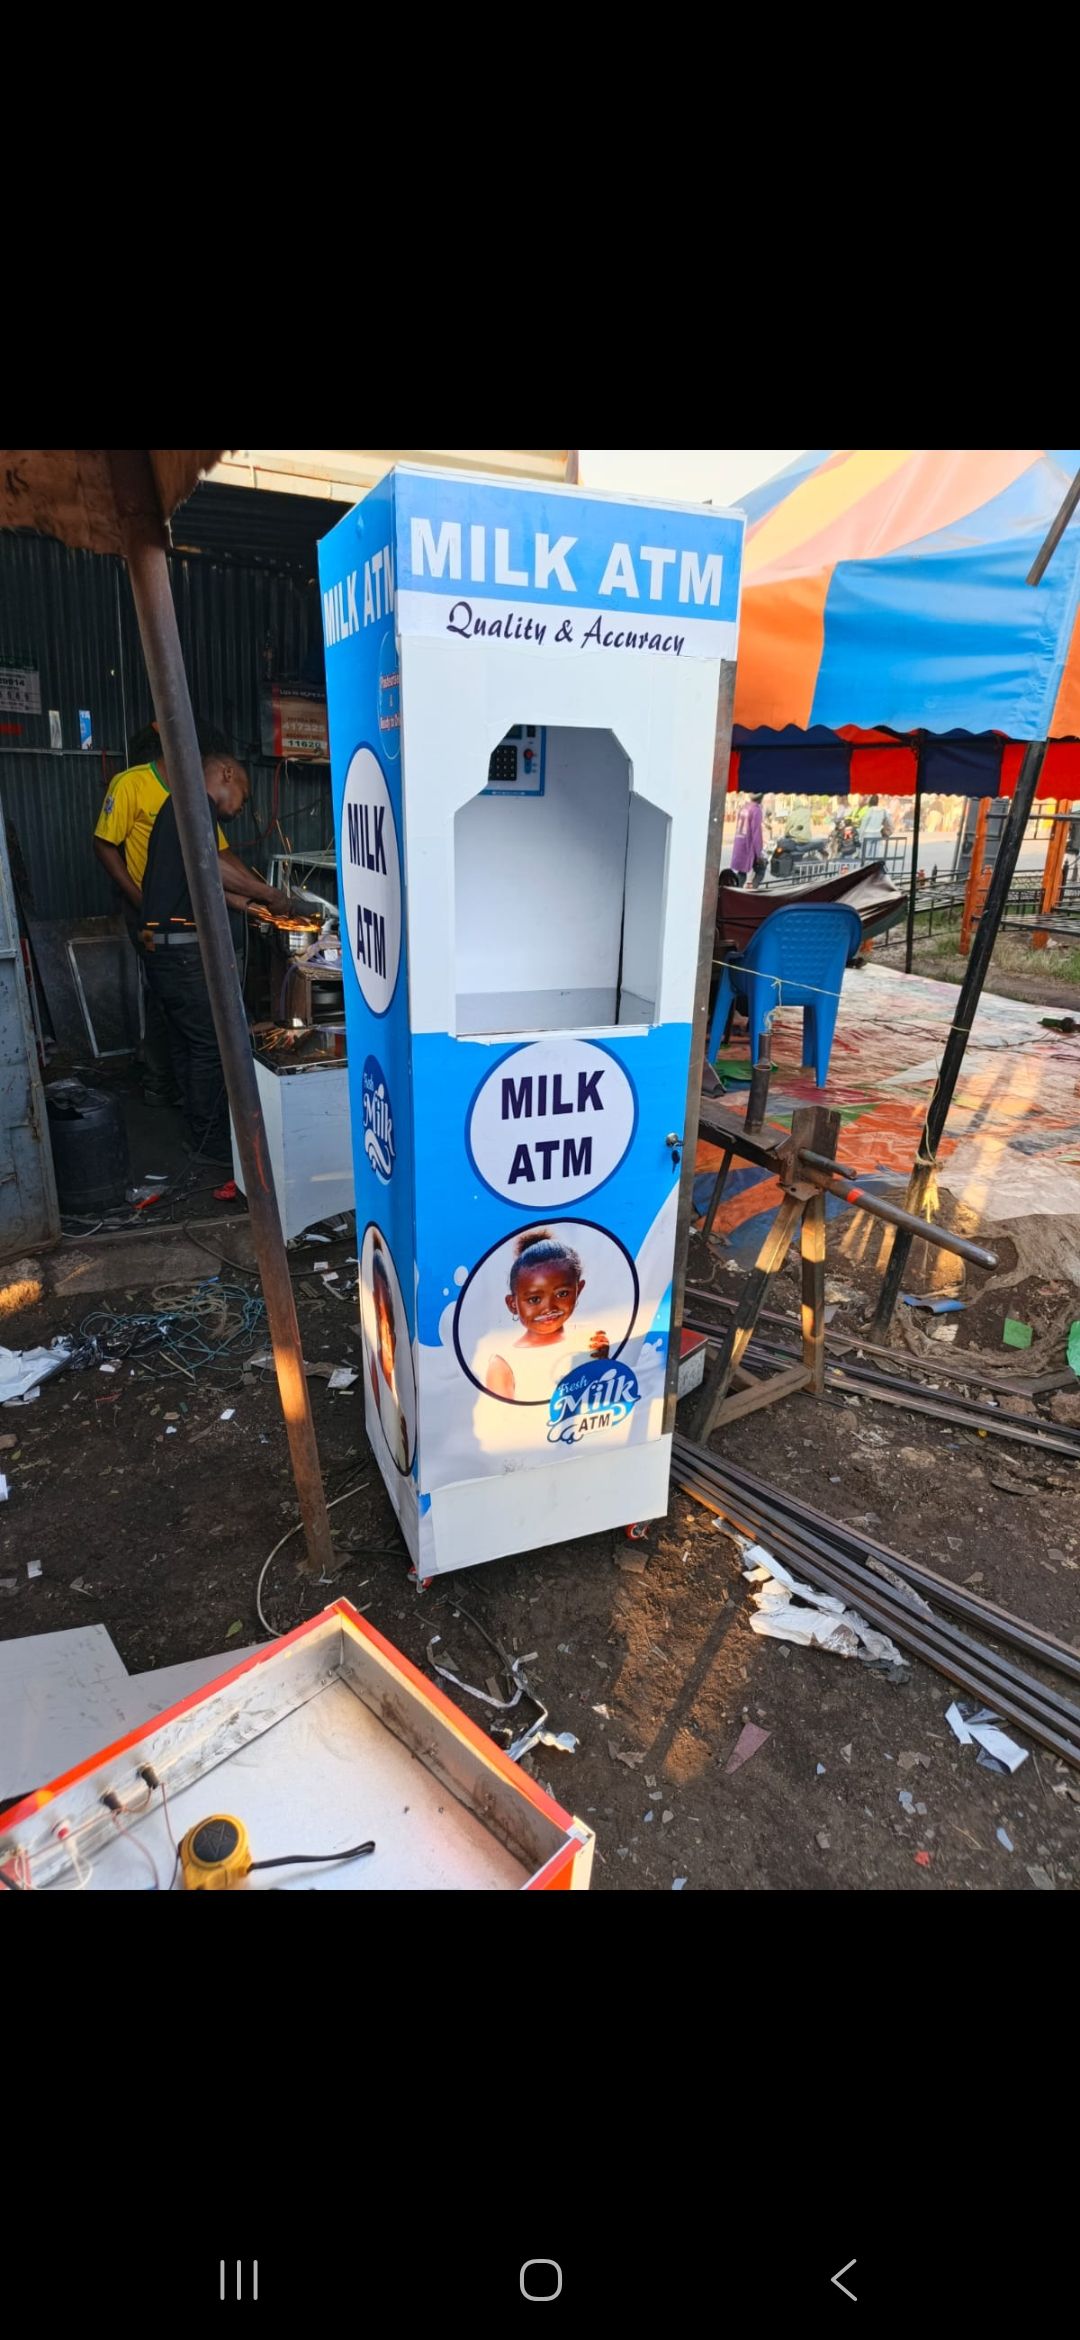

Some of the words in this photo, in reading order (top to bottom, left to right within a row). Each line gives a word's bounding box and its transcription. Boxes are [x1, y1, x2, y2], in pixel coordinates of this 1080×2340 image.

[410, 517, 578, 593] MILK
[598, 542, 724, 607] ATM
[323, 570, 360, 648] MILK
[446, 600, 547, 645] Quality
[554, 619, 574, 643] &
[580, 615, 686, 656] Accuracy
[347, 802, 387, 877] MILK
[356, 905, 387, 980] ATM
[363, 1084, 396, 1157] Milk
[501, 1070, 606, 1121] MILK
[507, 1136, 593, 1185] ATM
[546, 1368, 642, 1426] Milk
[558, 1375, 588, 1397] Fresh
[578, 1413, 611, 1433] ATM
